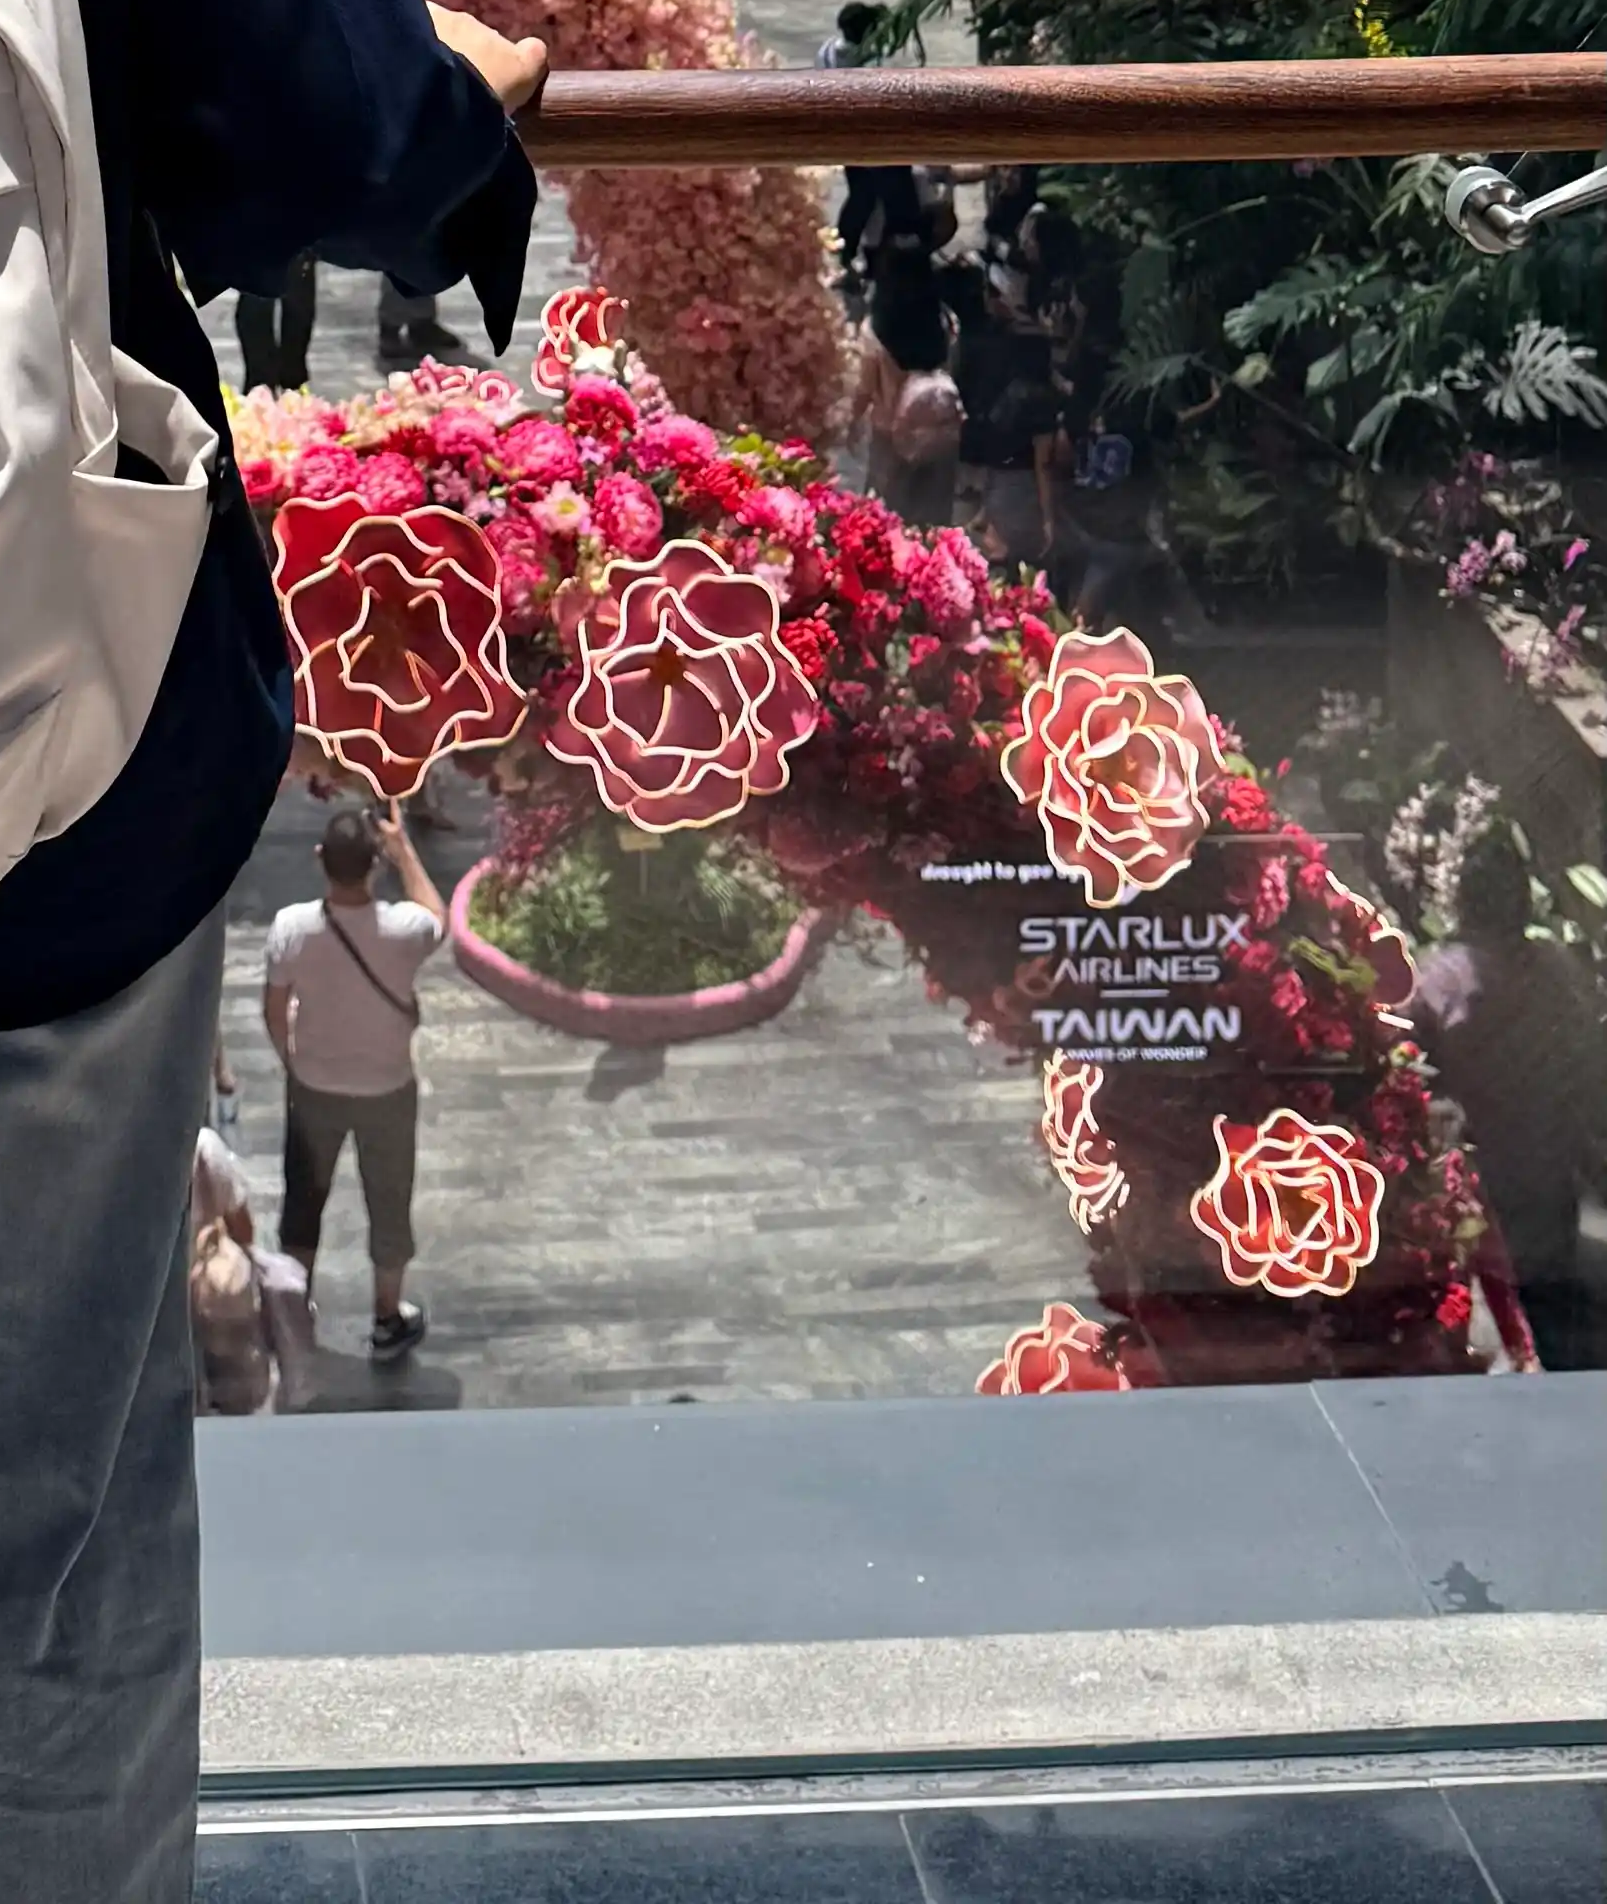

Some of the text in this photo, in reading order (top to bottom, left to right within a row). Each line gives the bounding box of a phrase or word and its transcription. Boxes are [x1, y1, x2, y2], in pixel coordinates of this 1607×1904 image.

[1019, 913, 1251, 952] STARLUX
[1054, 954, 1221, 984] AIRLINES
[1031, 1006, 1242, 1043] TAIWAN
